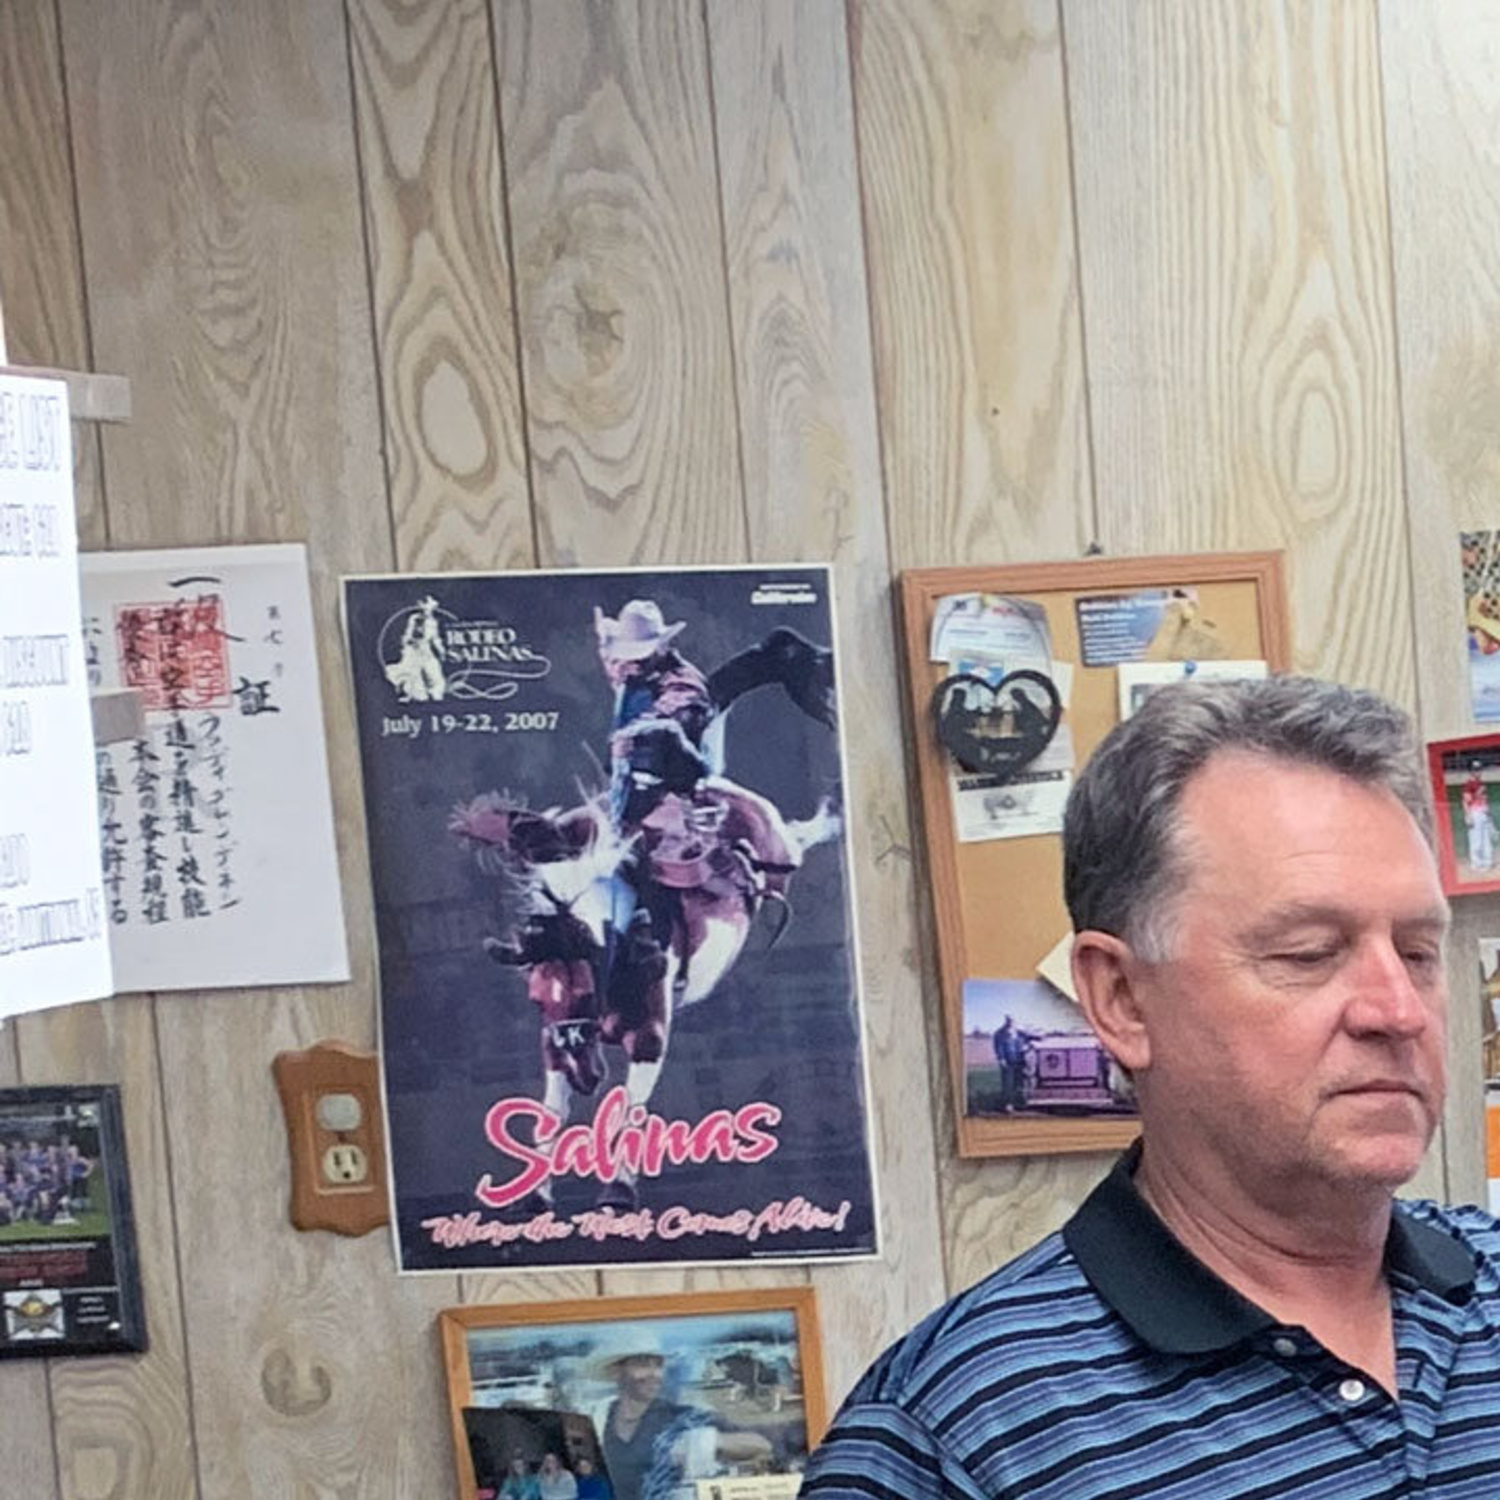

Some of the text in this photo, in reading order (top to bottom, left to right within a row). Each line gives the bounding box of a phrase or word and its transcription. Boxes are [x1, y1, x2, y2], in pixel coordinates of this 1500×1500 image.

[446, 628, 517, 646] RODEO
[447, 645, 534, 664] SALINAS
[382, 711, 560, 738] July 19-22, 2007
[475, 1085, 782, 1208] Salinas
[421, 1211, 519, 1248] Where
[520, 1211, 575, 1244] the
[571, 1207, 656, 1241] West
[656, 1206, 751, 1240] Comes
